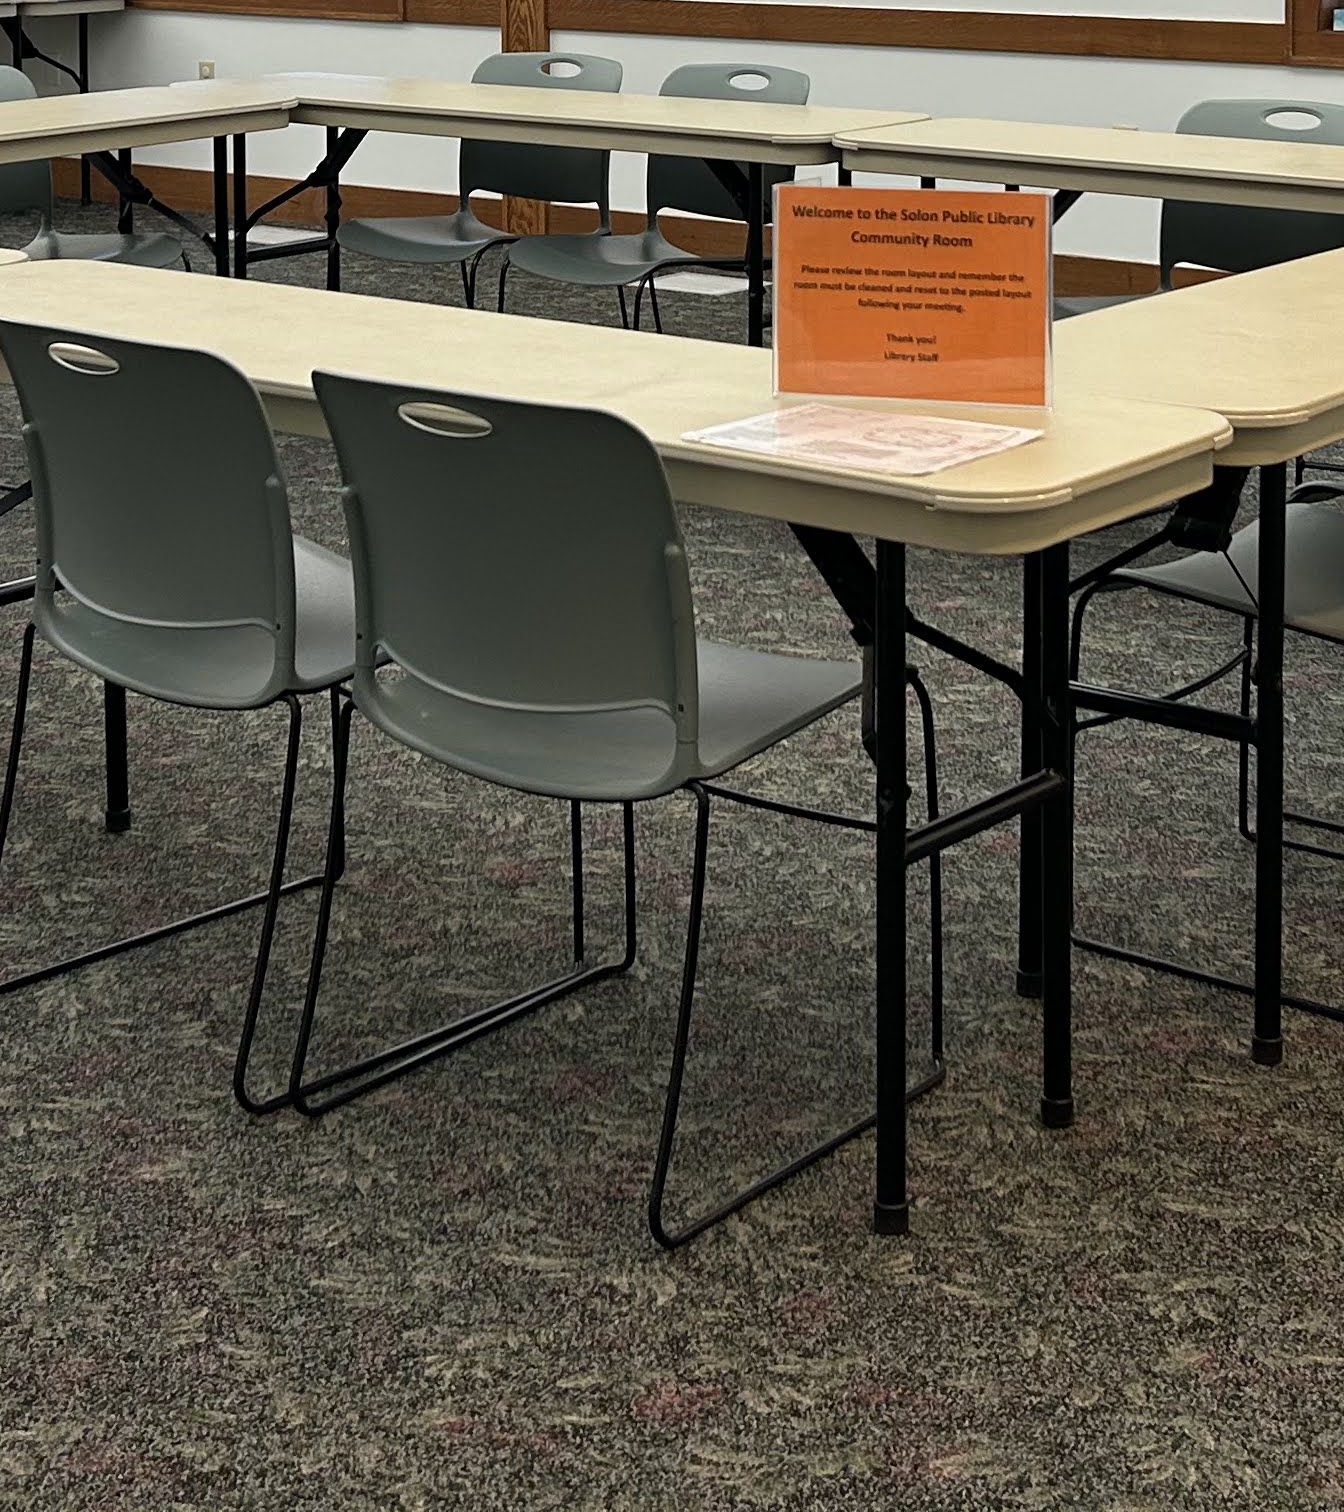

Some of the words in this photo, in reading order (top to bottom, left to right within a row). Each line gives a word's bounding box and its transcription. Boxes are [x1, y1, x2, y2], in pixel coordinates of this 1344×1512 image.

[792, 205, 853, 219] Welcome
[857, 208, 871, 220] to
[875, 208, 897, 221] the
[900, 209, 938, 222] Solon
[942, 210, 984, 224] Public
[987, 212, 1035, 228] Library
[851, 230, 929, 248] Community
[933, 234, 973, 247] Room
[801, 264, 829, 274] Please
[831, 266, 862, 275] review
[864, 266, 879, 276] the
[882, 269, 906, 277] room
[908, 268, 937, 279] layout
[939, 270, 956, 279] and
[958, 272, 1006, 282] remember
[1008, 273, 1025, 282] the
[820, 282, 842, 290] must
[844, 281, 856, 291] be
[858, 282, 893, 293] cleaned
[895, 285, 912, 293] and
[914, 286, 938, 294] reset
[940, 287, 949, 295] to
[951, 286, 967, 296] the
[969, 288, 1001, 298] posted
[1002, 289, 1032, 299] layout
[858, 298, 899, 310] following
[902, 302, 923, 311] your
[924, 302, 965, 313] meeting.
[886, 333, 913, 343] Thank
[884, 350, 915, 362] Library
[918, 353, 939, 362] Staff
